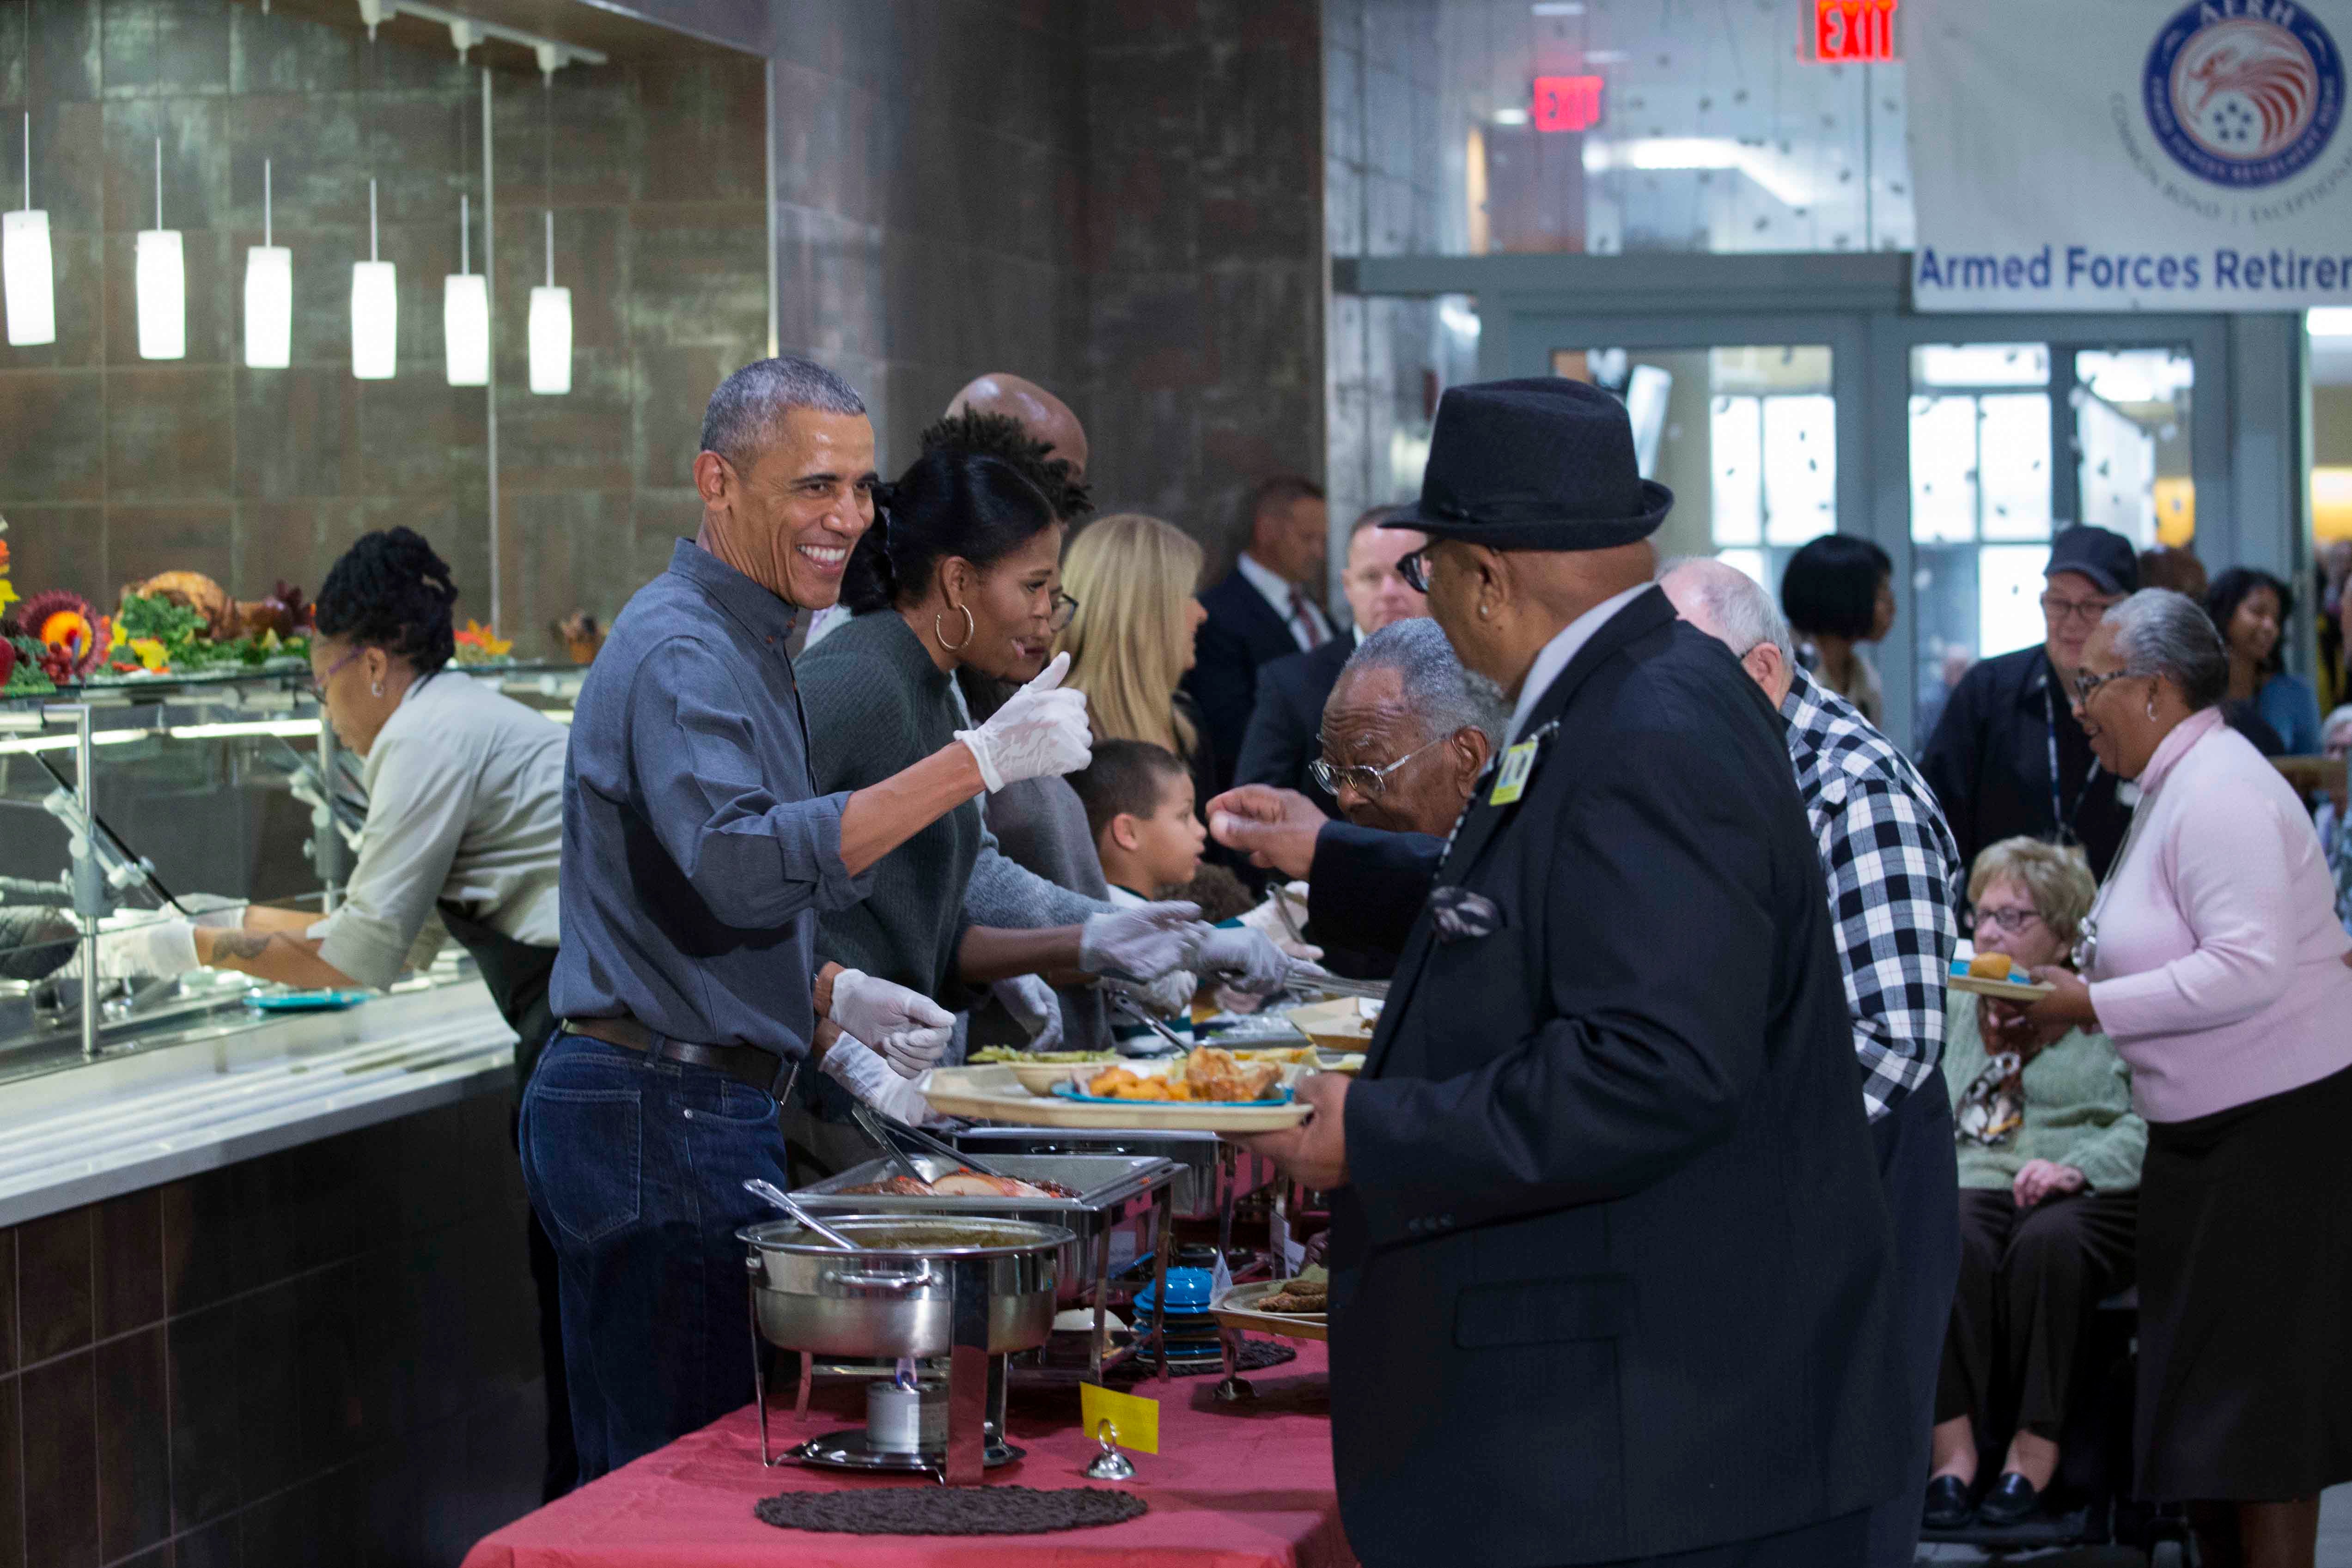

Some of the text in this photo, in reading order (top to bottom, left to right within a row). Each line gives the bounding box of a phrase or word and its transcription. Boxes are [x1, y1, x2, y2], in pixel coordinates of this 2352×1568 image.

[1816, 0, 1897, 61] EXIT
[1535, 77, 1604, 132] EXIT
[1919, 243, 2051, 288] Armed
[2066, 245, 2199, 289] Forces
